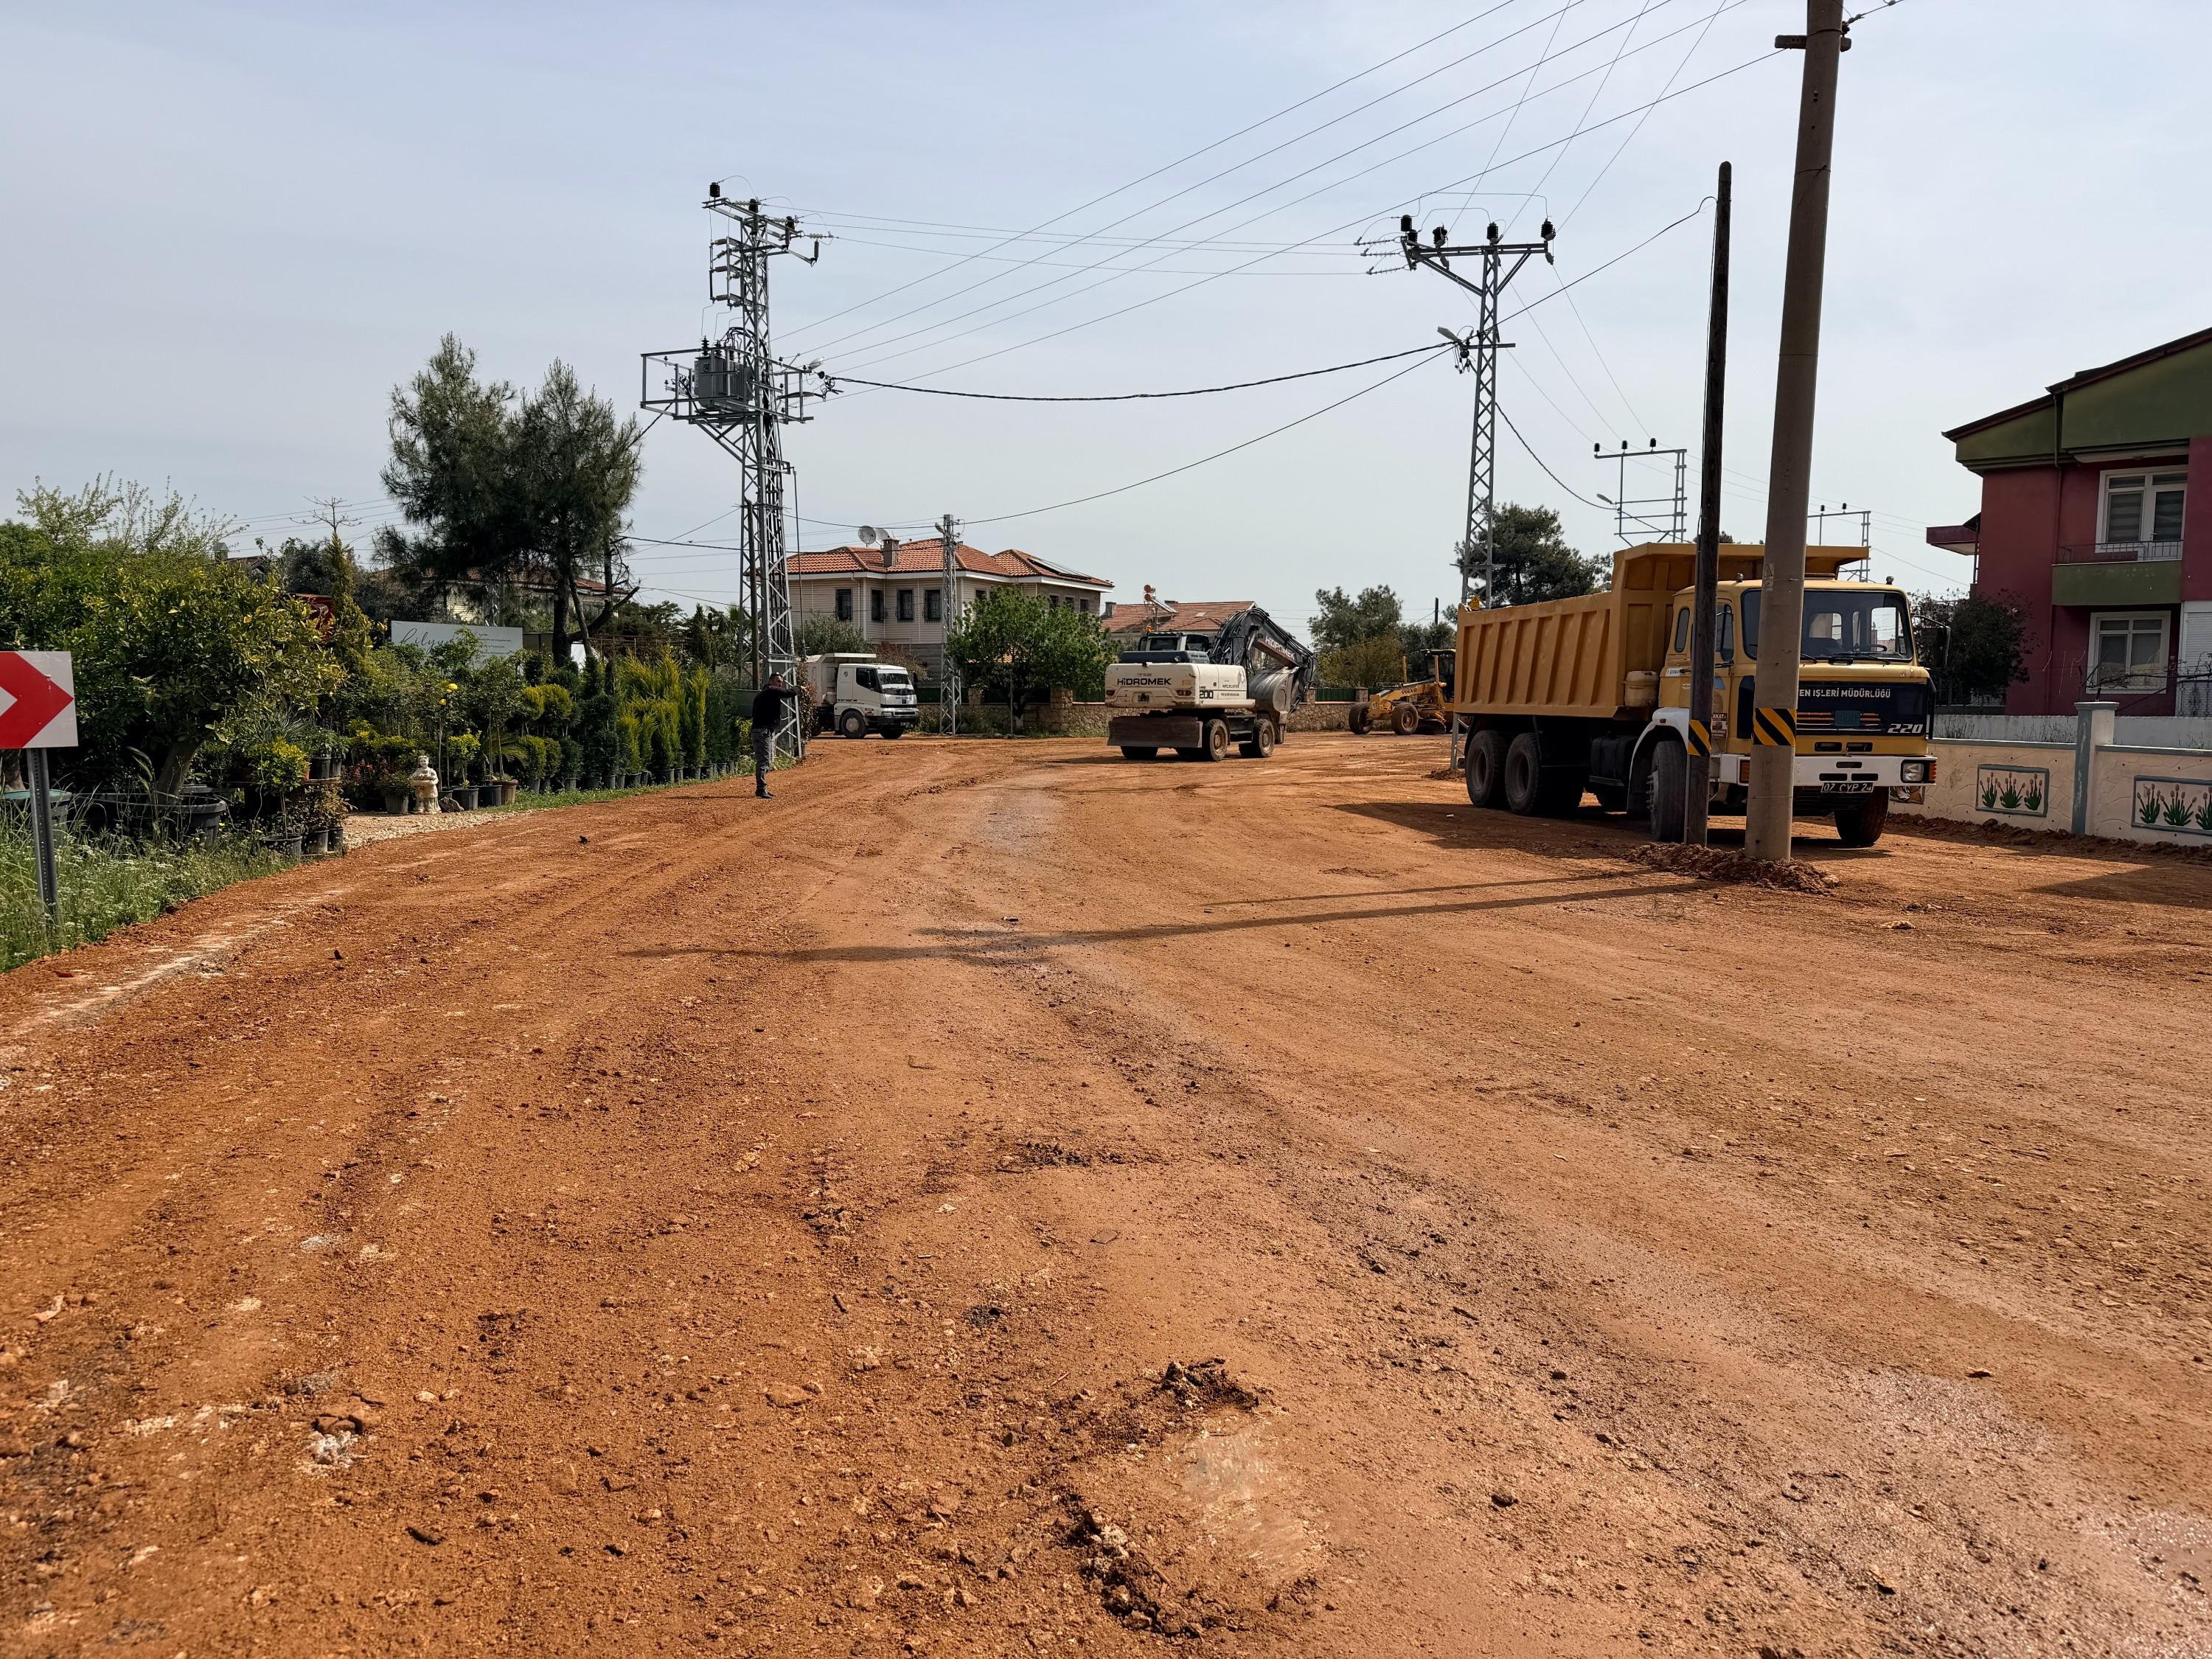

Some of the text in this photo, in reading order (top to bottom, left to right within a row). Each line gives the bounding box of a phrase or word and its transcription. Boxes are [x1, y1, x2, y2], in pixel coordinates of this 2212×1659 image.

[1799, 689, 1811, 697] EN
[1840, 687, 1891, 698] MÜDÜRLÜĞÜ
[1887, 723, 1924, 734] 220
[1823, 783, 1836, 791] 07
[1839, 783, 1859, 792] CYP
